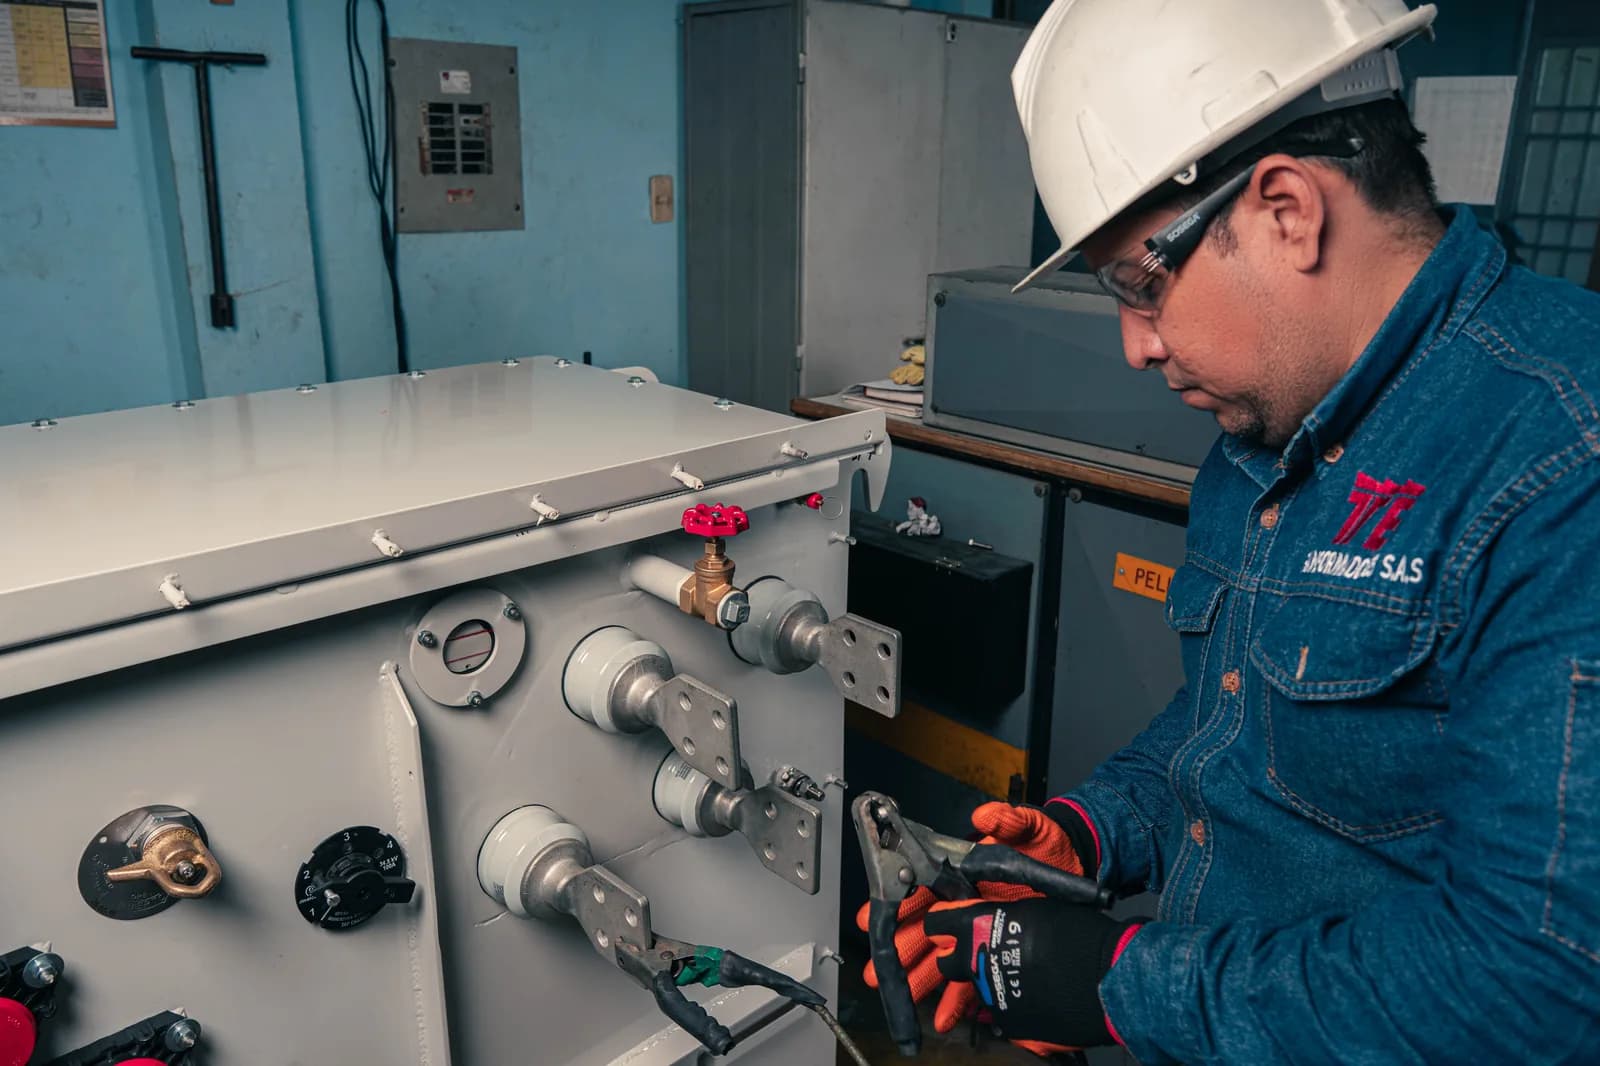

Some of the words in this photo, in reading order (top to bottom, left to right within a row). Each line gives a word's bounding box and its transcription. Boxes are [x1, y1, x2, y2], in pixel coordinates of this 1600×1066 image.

[343, 832, 351, 841] 3
[386, 840, 393, 849] 4
[303, 871, 311, 880] 2
[309, 908, 315, 917] 1
[1009, 979, 1022, 999] CE
